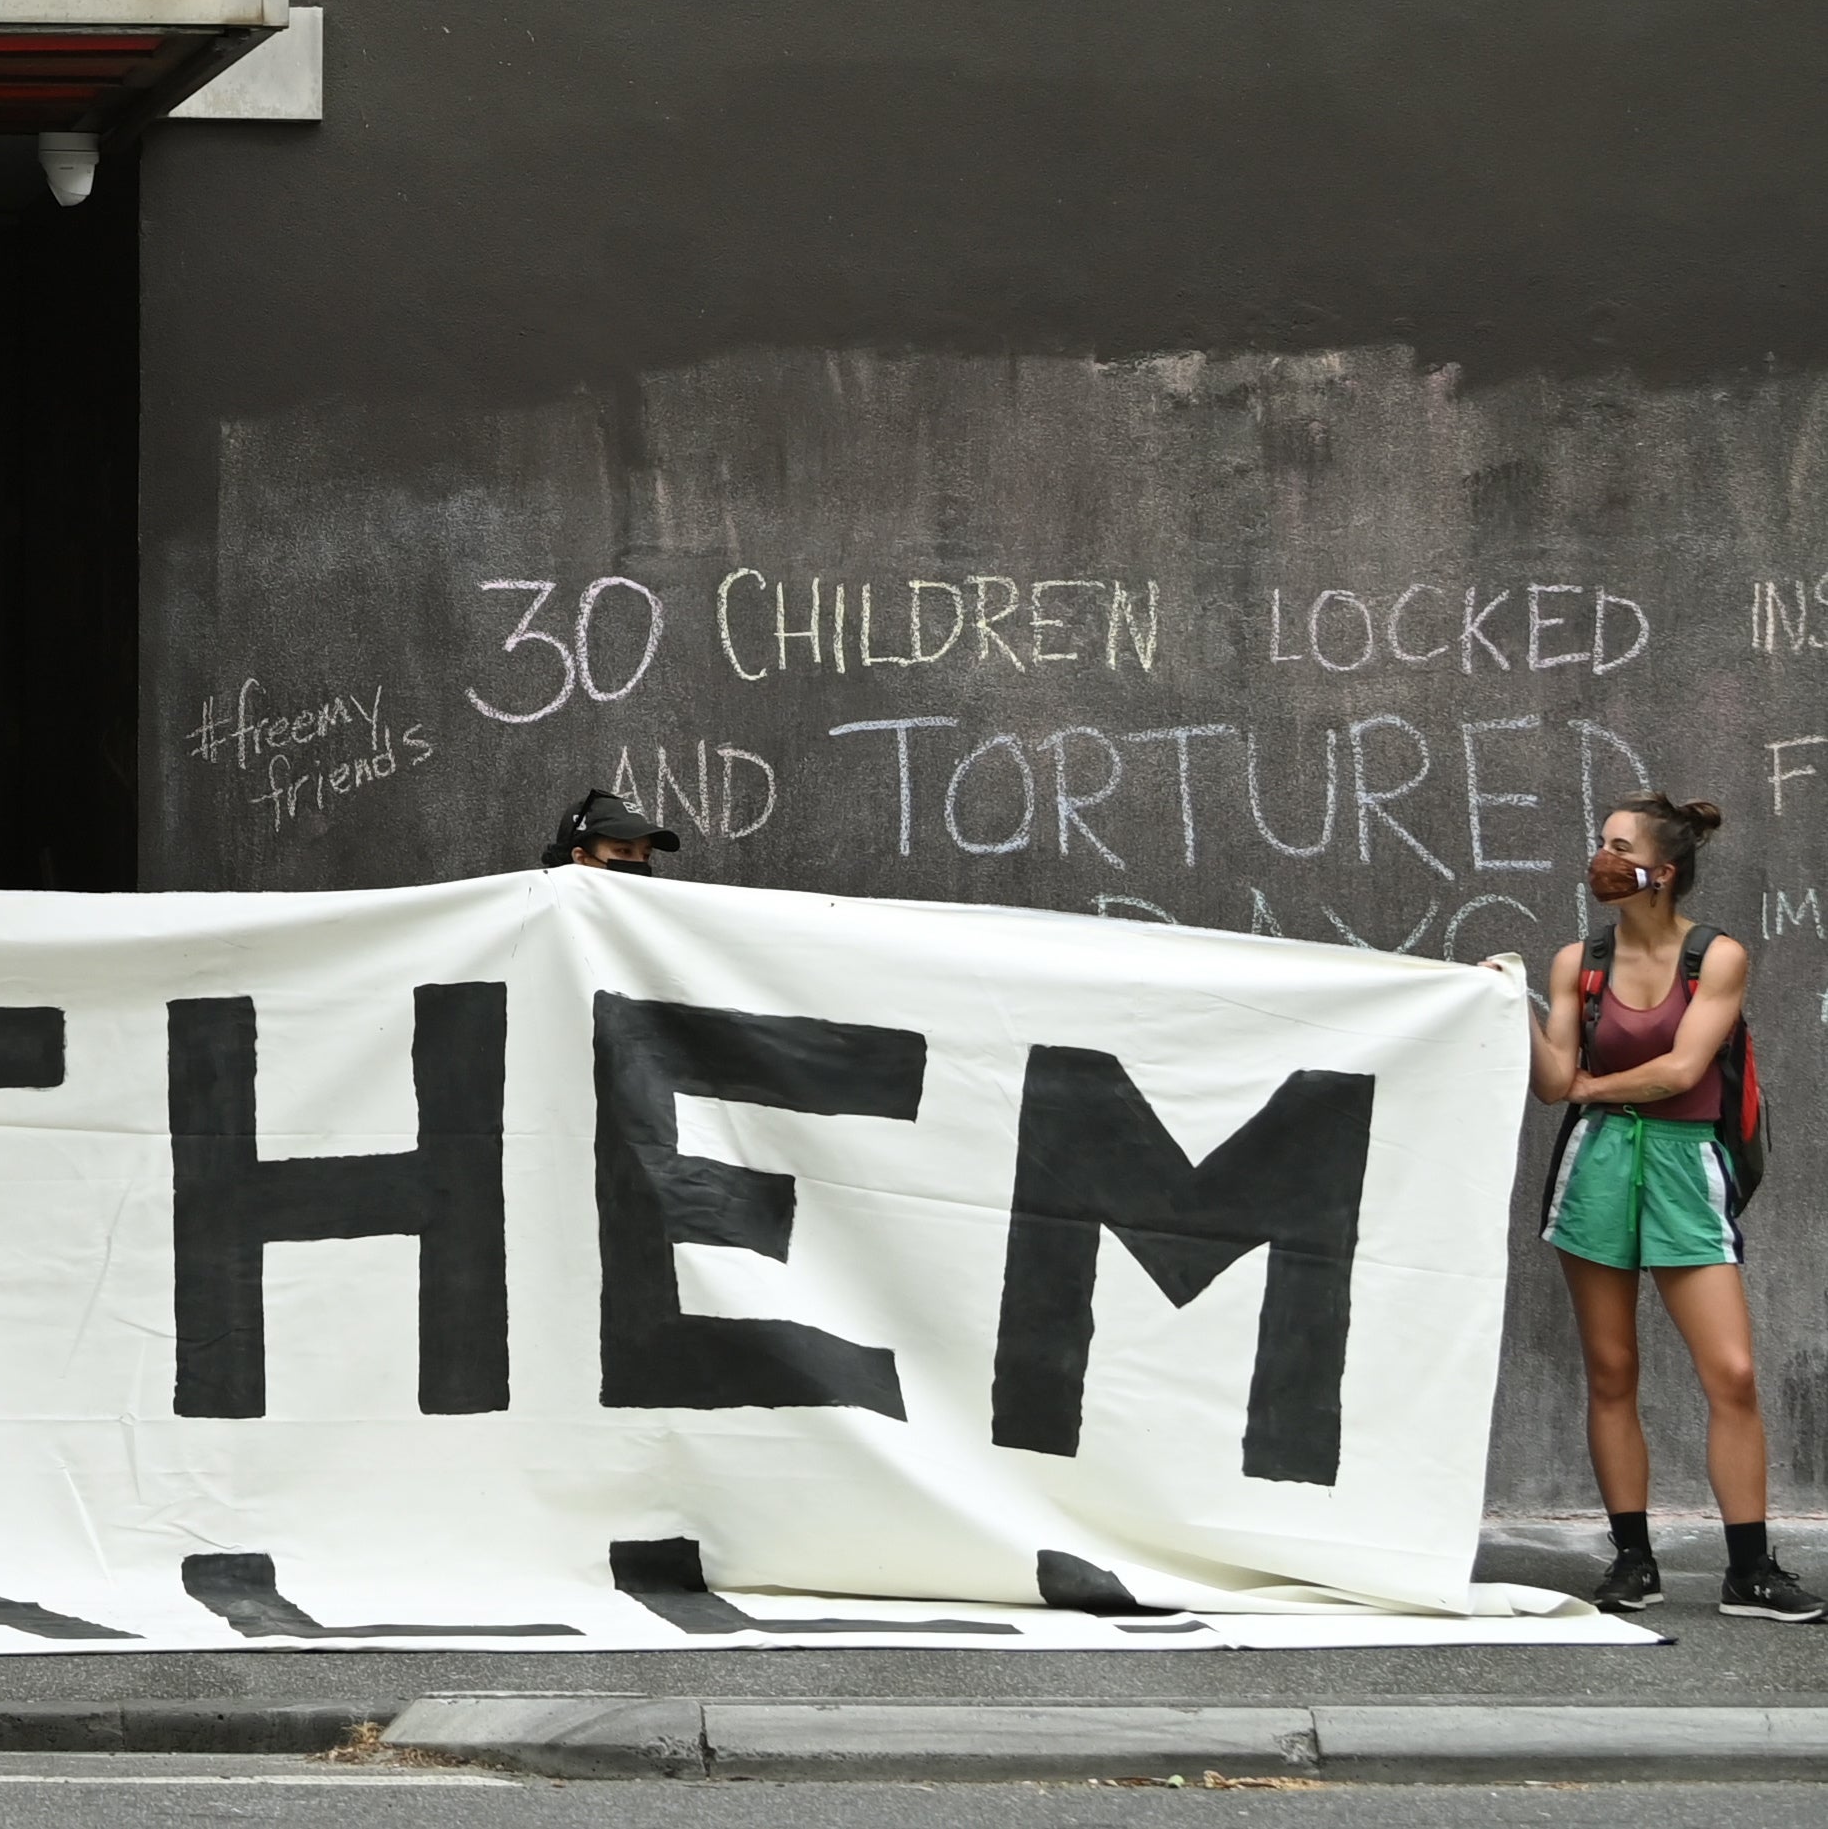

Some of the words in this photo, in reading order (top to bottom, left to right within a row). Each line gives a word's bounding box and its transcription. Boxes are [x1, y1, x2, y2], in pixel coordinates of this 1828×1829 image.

[465, 577, 664, 723] 30
[717, 567, 1161, 681] CHILDREN
[1269, 583, 1650, 675] LOCKED
[252, 724, 434, 833] friends
